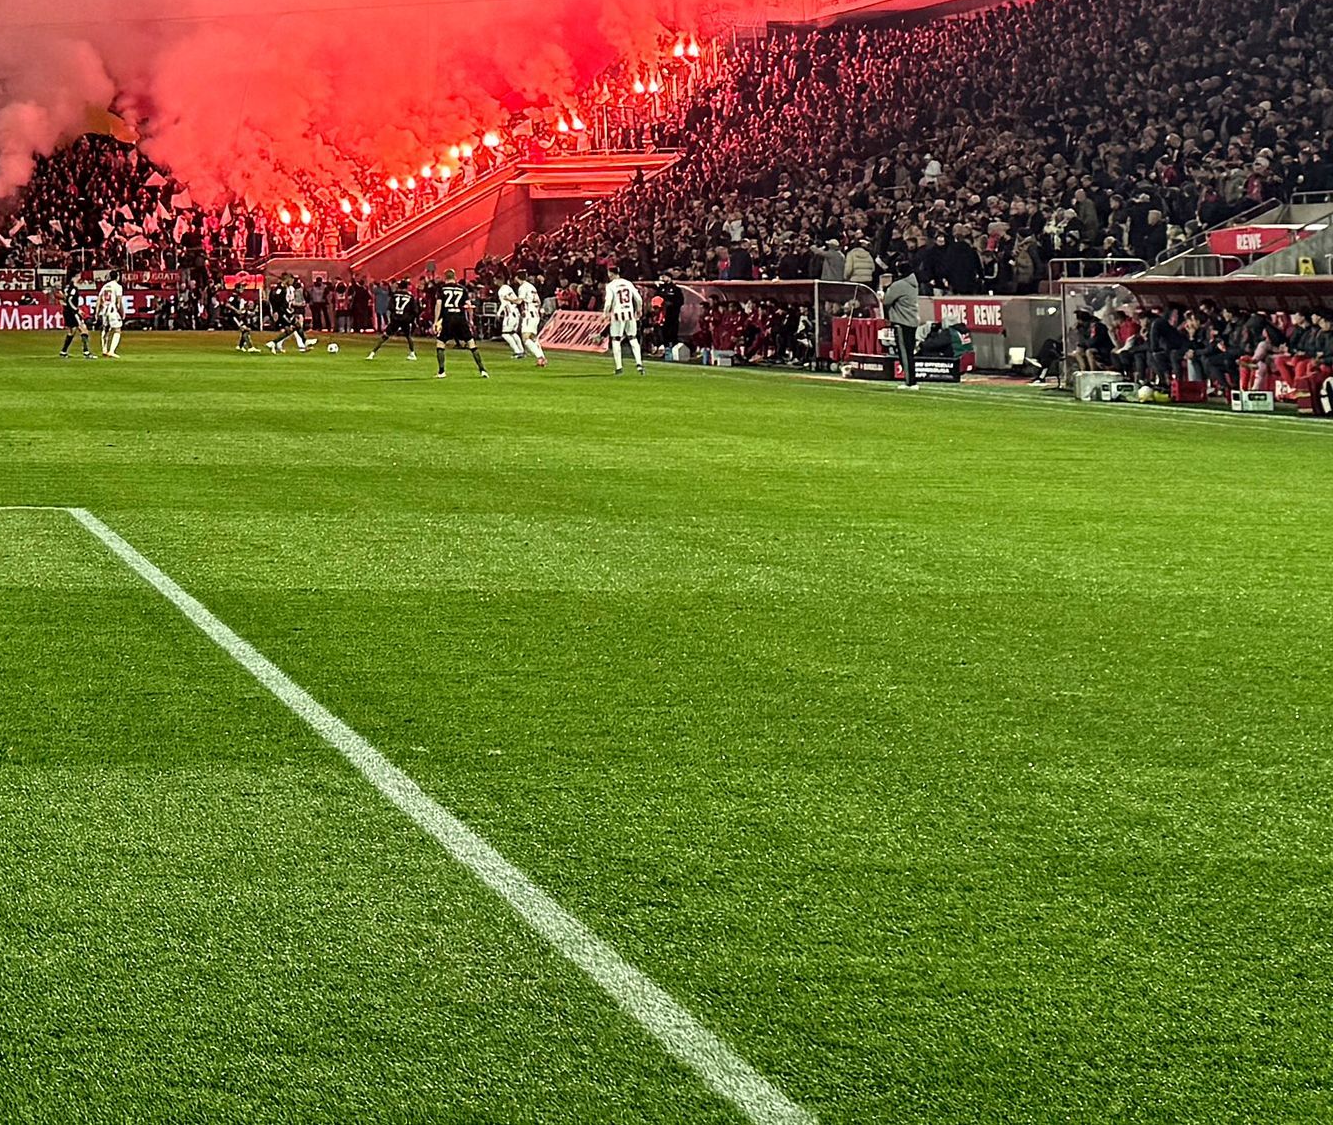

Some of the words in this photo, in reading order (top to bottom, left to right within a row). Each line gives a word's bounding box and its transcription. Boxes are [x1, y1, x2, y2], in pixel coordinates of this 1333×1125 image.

[1236, 232, 1262, 251] REWE
[394, 296, 410, 311] 17
[443, 289, 463, 308] 27
[617, 289, 630, 304] 13
[0, 307, 66, 330] Markt
[974, 305, 1002, 326] REWE
